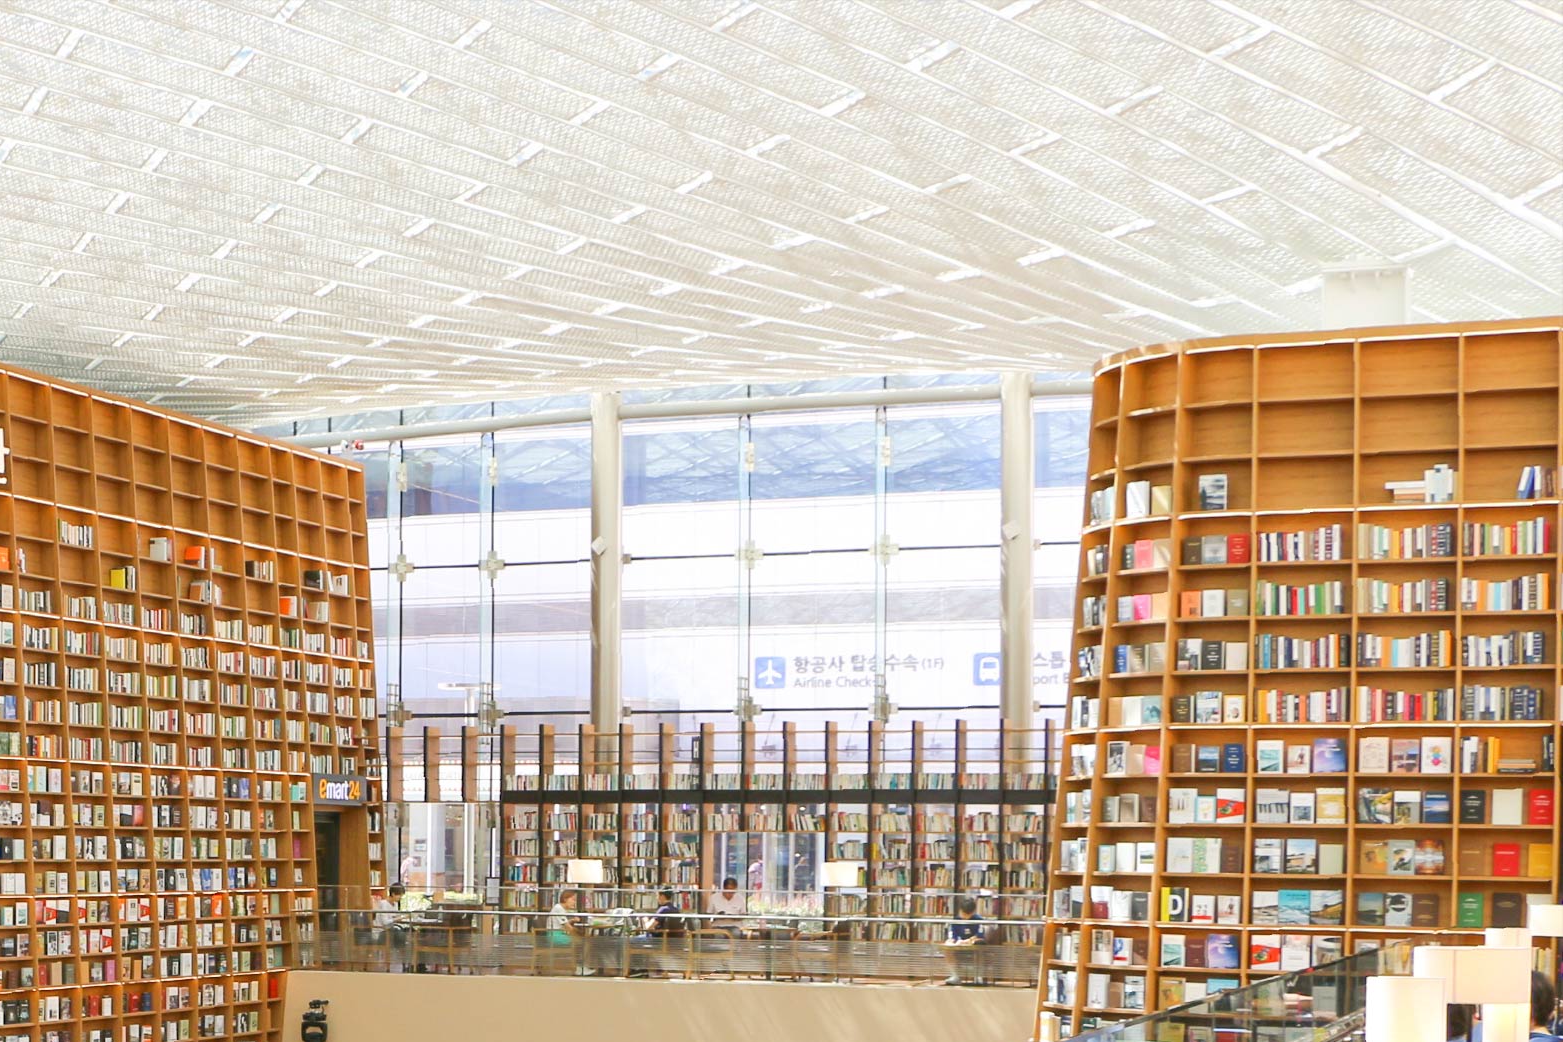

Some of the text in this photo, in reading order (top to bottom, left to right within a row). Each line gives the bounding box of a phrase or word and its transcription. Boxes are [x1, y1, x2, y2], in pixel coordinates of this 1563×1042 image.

[793, 655, 845, 674] 항공사
[793, 677, 886, 689] Airline Check-
[318, 778, 361, 801] emart24
